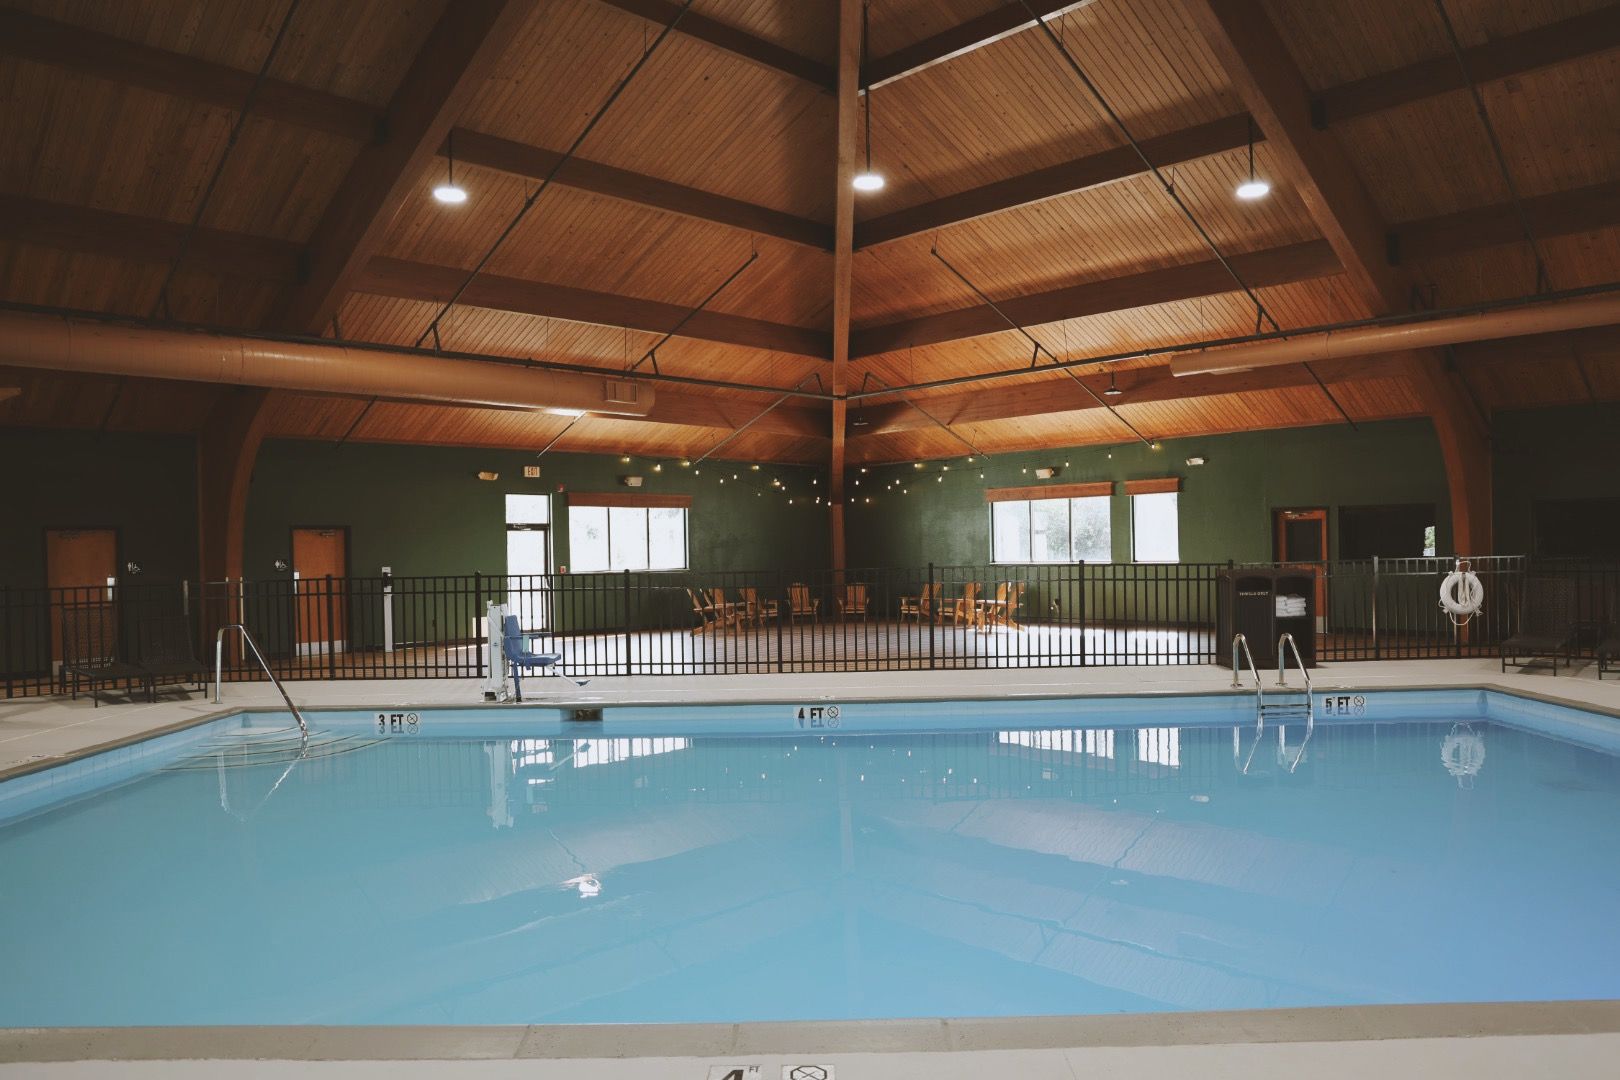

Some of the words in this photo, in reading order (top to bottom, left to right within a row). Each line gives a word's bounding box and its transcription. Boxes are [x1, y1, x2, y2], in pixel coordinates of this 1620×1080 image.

[1338, 697, 1350, 707] FT
[798, 707, 805, 718] 4
[811, 707, 824, 718] FT
[379, 714, 386, 725] 3
[391, 714, 404, 725] FT
